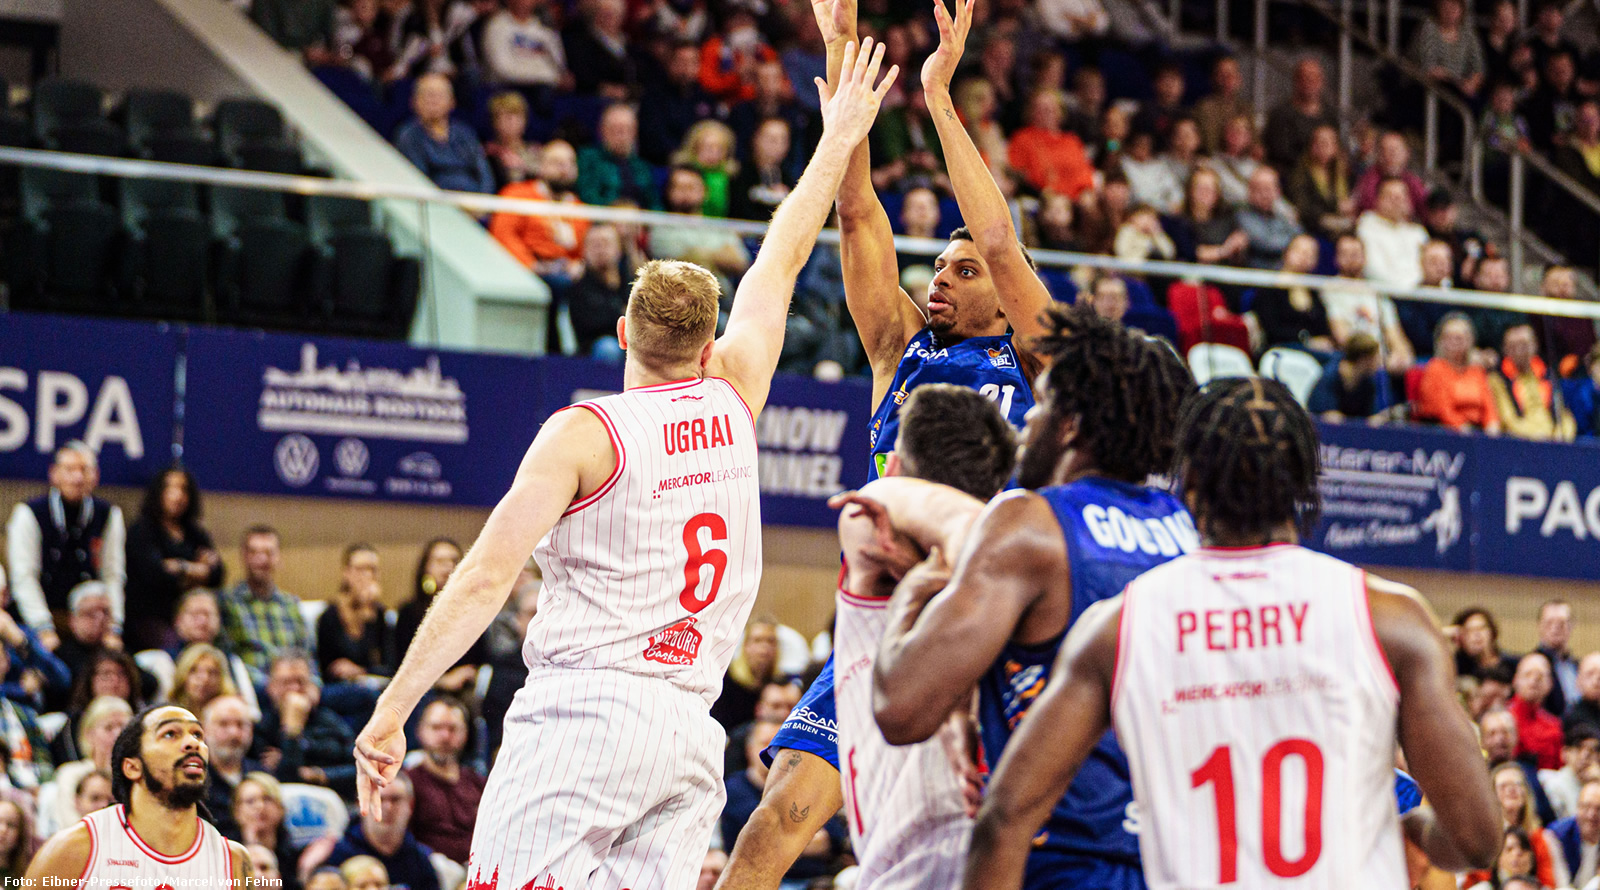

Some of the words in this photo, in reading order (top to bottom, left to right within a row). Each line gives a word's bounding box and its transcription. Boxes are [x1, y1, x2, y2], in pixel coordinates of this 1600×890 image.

[663, 414, 733, 455] UGRAI
[679, 512, 728, 614] 6
[1176, 601, 1309, 653] PERRY
[792, 722, 819, 735] BAUEN
[1189, 736, 1325, 884] 10
